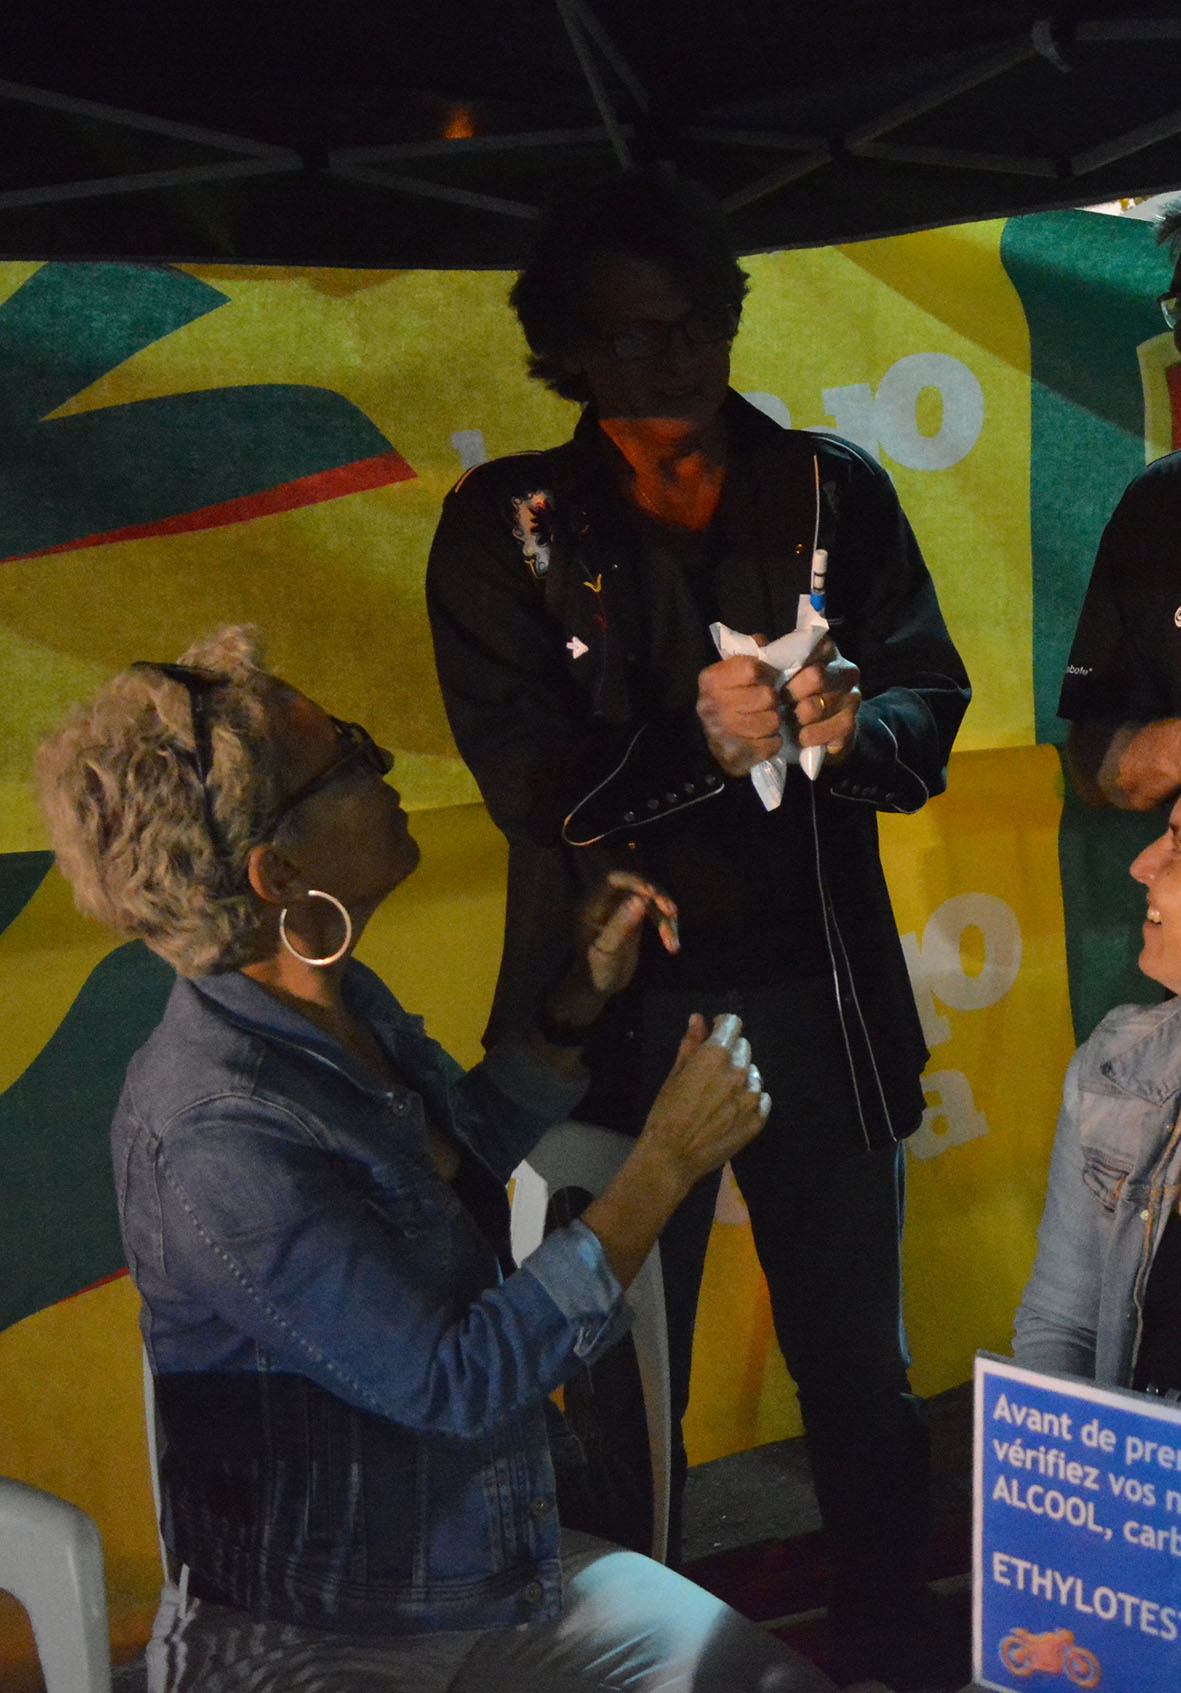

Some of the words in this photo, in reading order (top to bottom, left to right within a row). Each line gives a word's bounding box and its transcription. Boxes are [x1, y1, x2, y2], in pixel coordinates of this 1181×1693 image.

[992, 1394, 1072, 1440] Avant
[1080, 1419, 1116, 1450] de
[992, 1437, 1100, 1491] vérifiez
[1109, 1473, 1156, 1506] vos
[992, 1475, 1113, 1541] ALCOOL,
